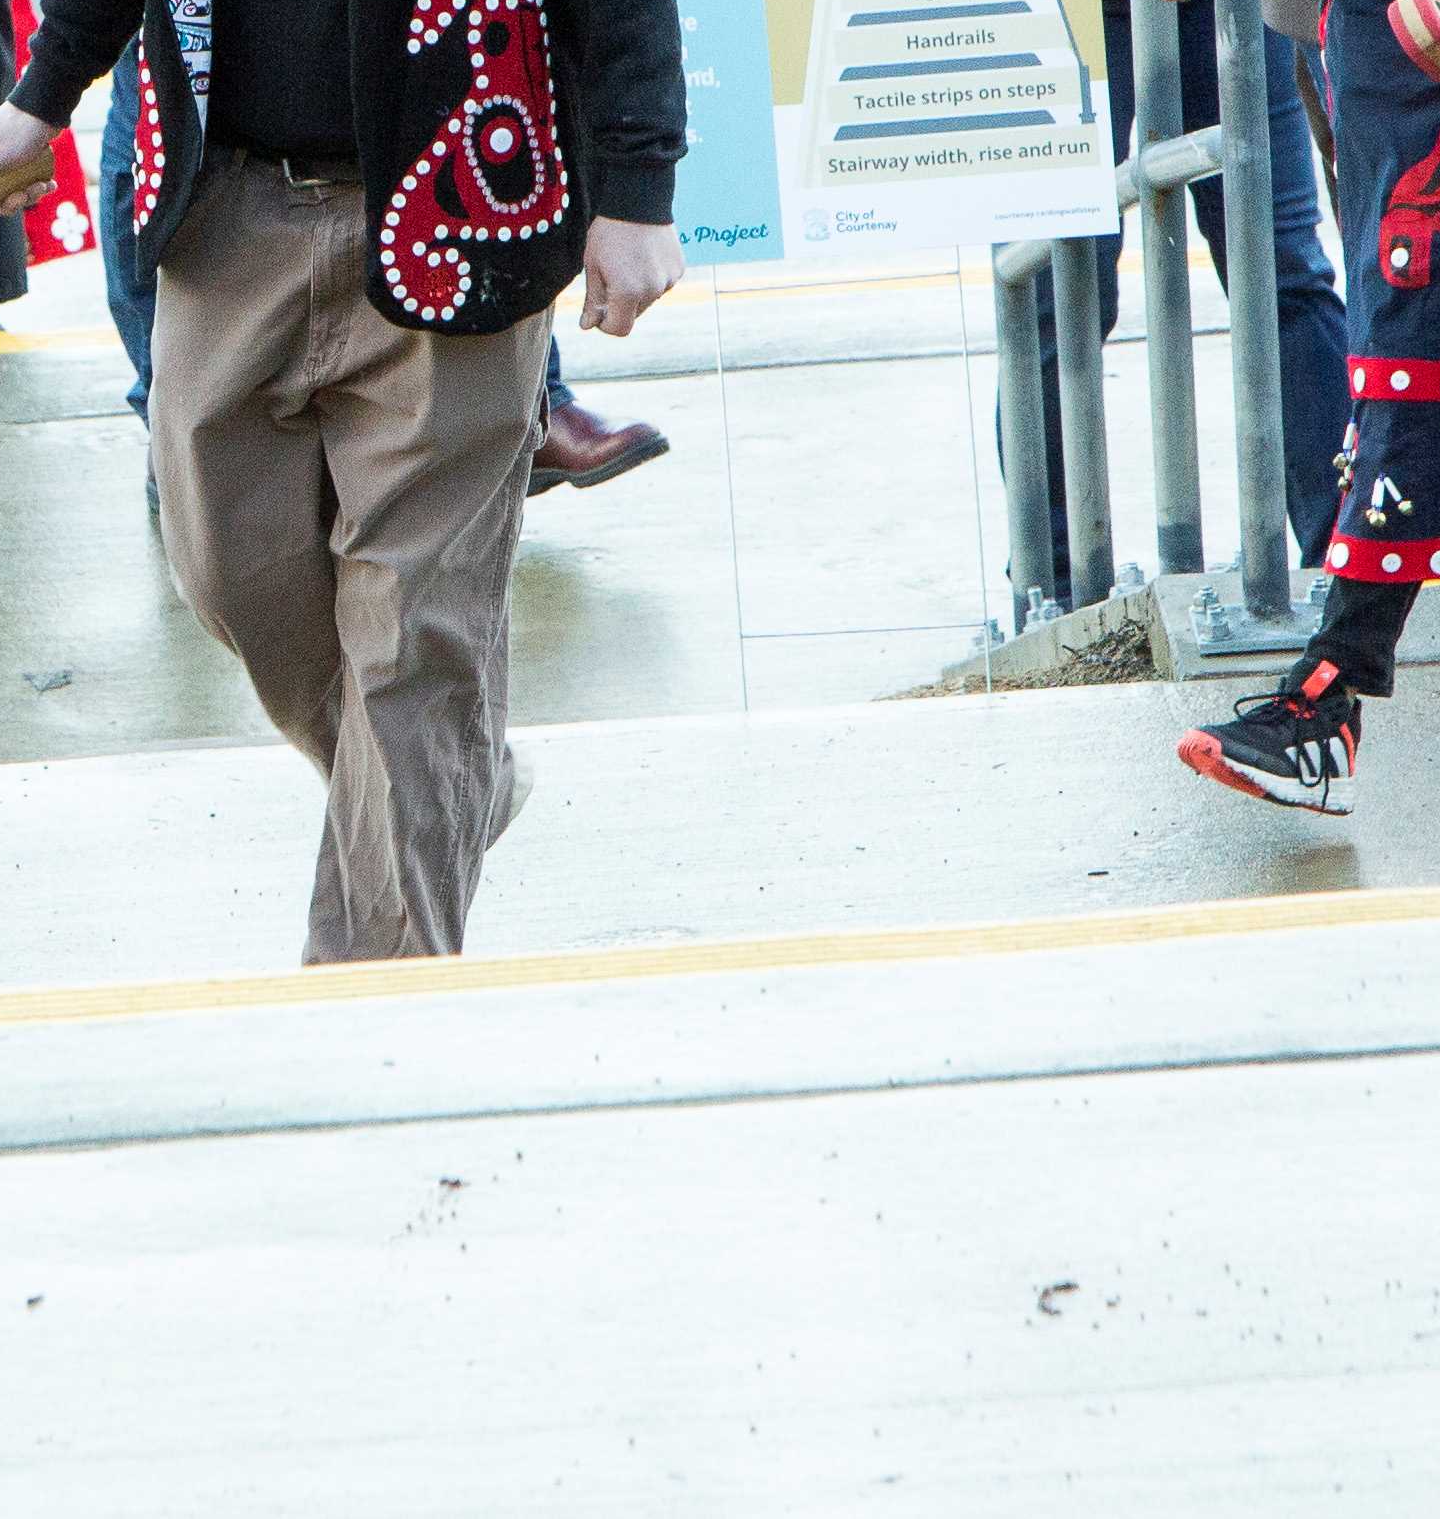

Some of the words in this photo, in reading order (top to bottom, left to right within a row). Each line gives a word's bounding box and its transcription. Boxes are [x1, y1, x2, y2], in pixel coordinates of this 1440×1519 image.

[906, 29, 996, 51] Handrails
[854, 91, 917, 110] Tactile
[921, 87, 973, 106] strips
[979, 86, 1002, 100] on
[1007, 81, 1056, 100] steps
[828, 153, 909, 174] Stairway
[914, 148, 974, 166] width,
[979, 146, 1013, 162] rise
[1018, 141, 1052, 159] and
[1059, 140, 1091, 155] run
[836, 211, 860, 223] City
[863, 209, 875, 220] of
[836, 221, 898, 233] Courtenay
[694, 223, 769, 247] Project
